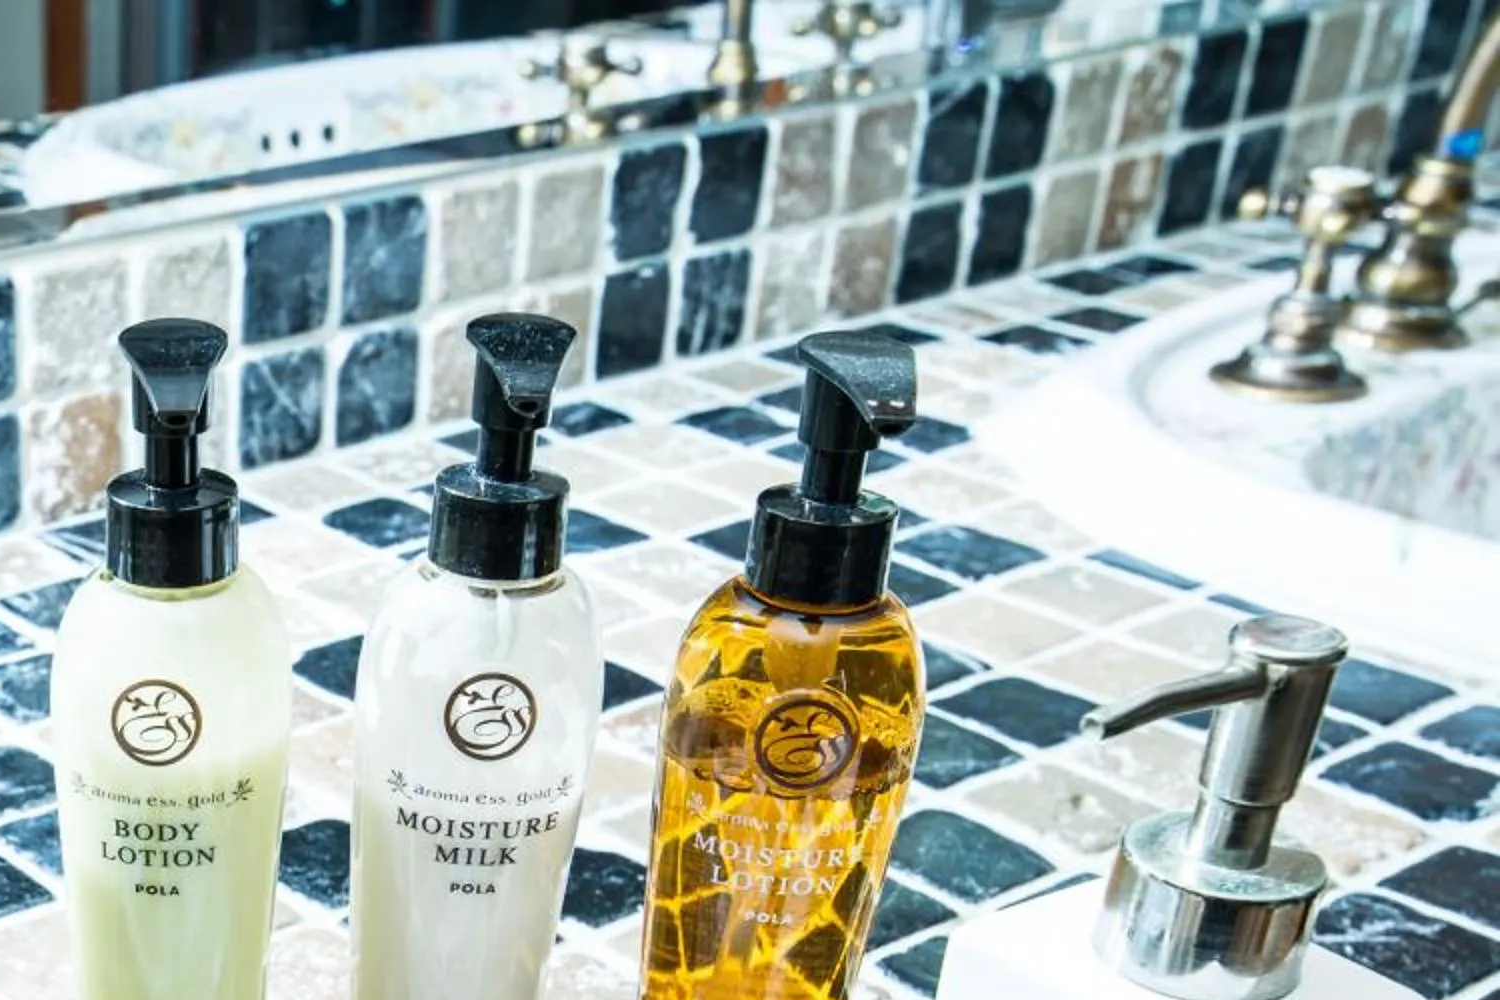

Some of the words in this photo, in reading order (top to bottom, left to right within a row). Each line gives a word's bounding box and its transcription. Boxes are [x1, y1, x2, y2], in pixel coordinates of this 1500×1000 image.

[92, 786, 141, 806] aroma
[187, 791, 226, 810] gold
[412, 783, 469, 804] aroma
[516, 788, 553, 807] gold
[114, 818, 199, 842] BODY
[395, 806, 560, 840] MOISTURE
[101, 841, 217, 868] LOTION
[435, 843, 518, 867] MILK
[693, 831, 865, 870] MOISTURE
[135, 883, 180, 896] POLA
[449, 882, 496, 895] POLA
[711, 864, 836, 896] LOTION
[744, 910, 794, 925] POLA
